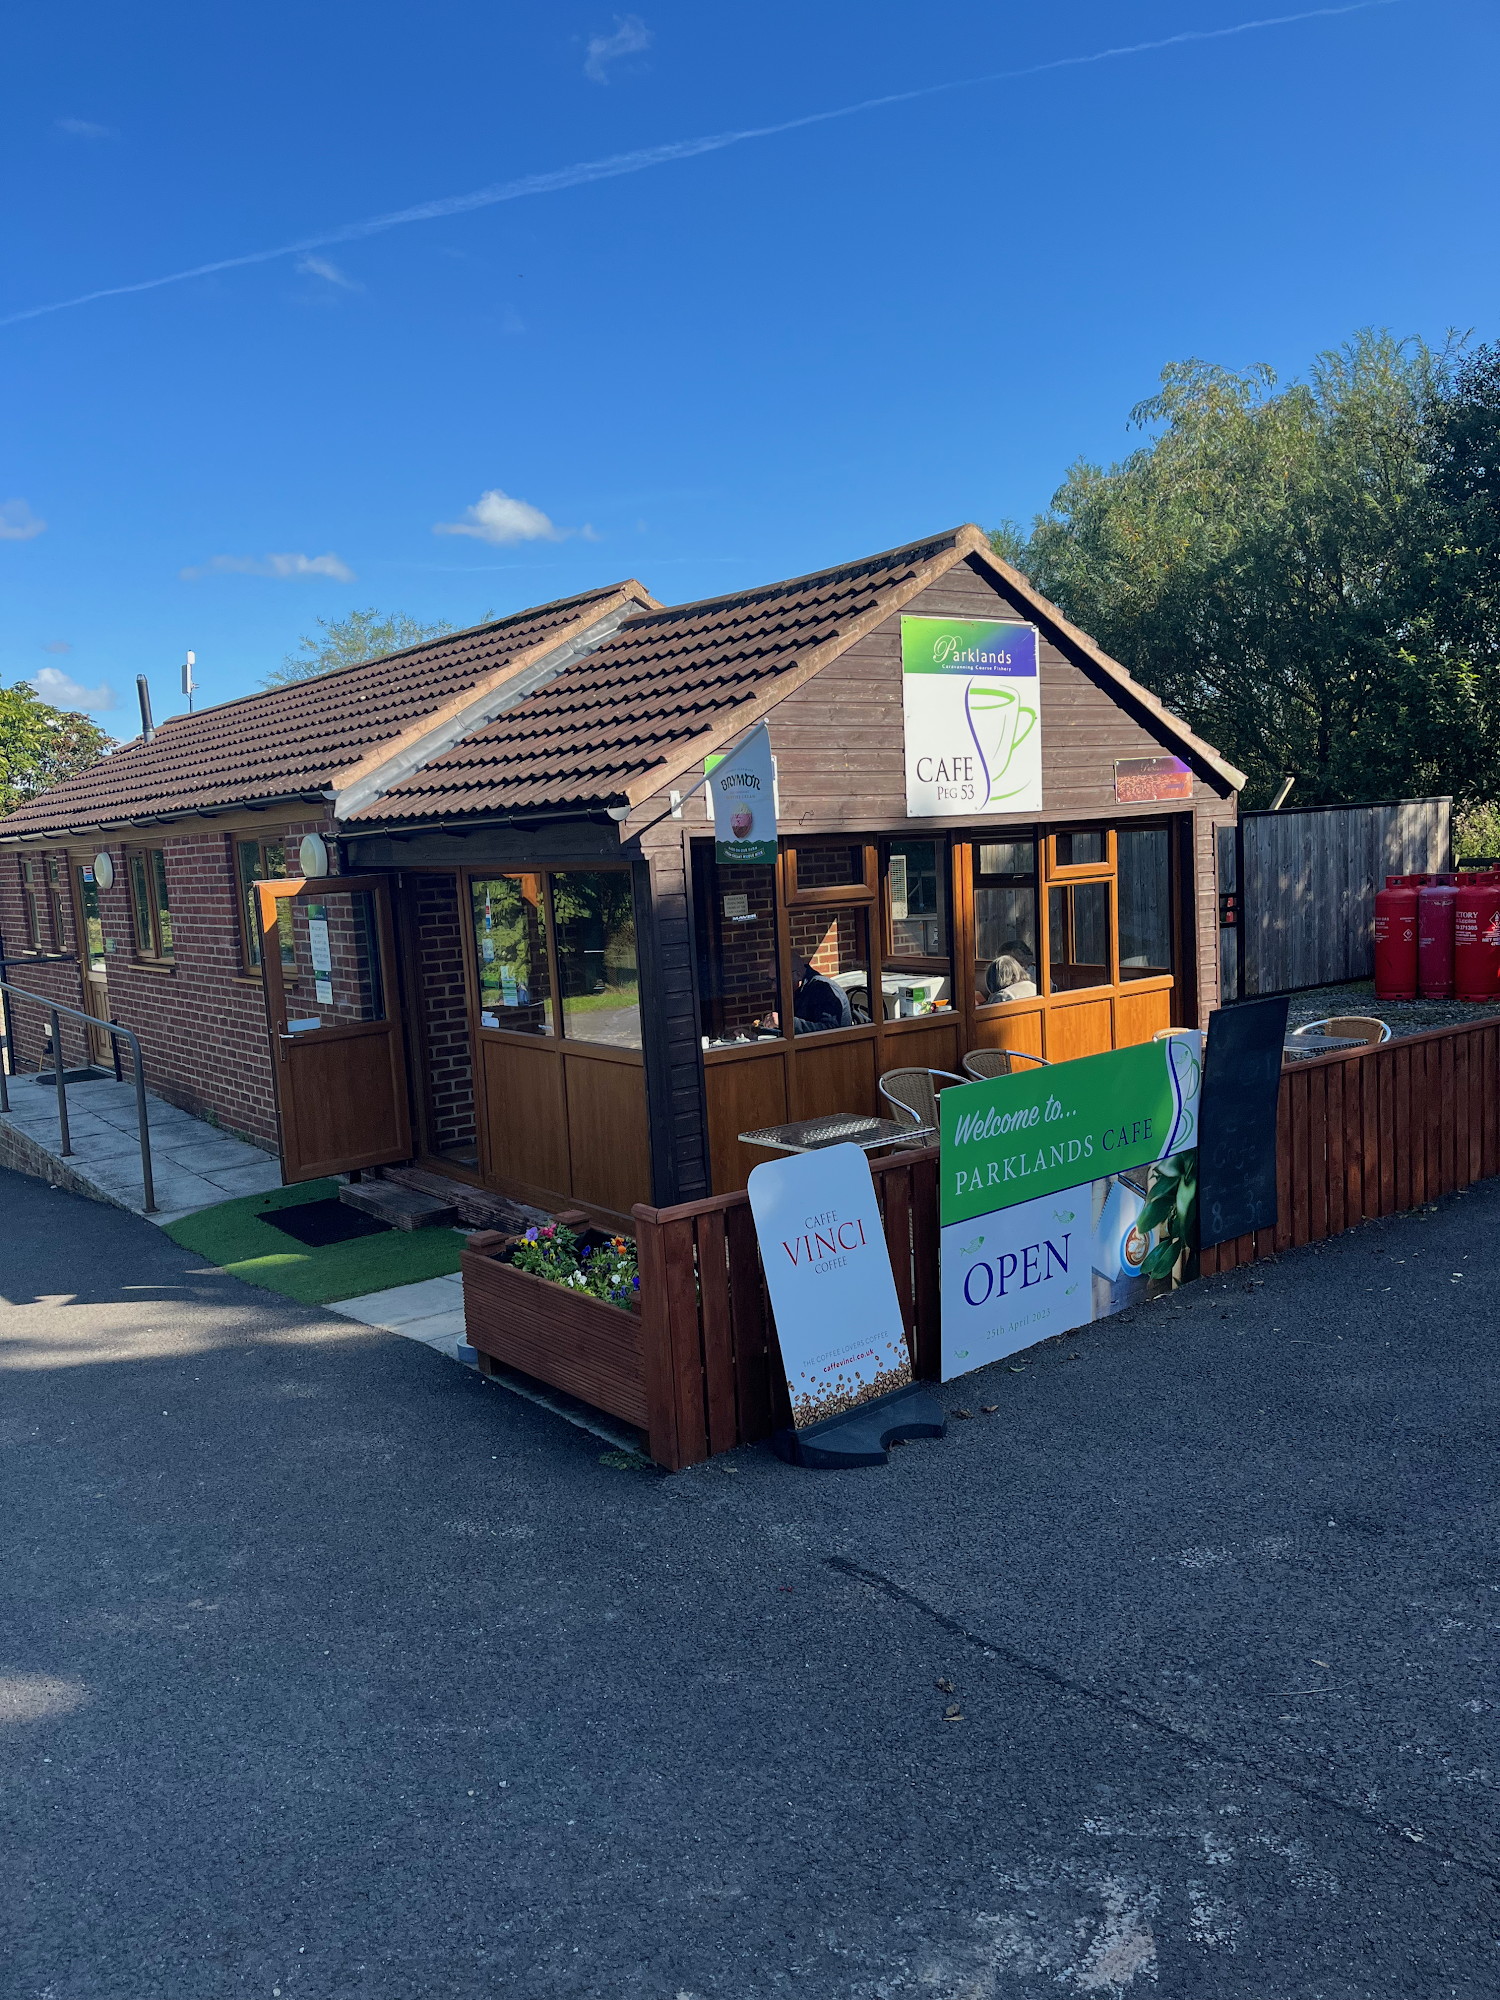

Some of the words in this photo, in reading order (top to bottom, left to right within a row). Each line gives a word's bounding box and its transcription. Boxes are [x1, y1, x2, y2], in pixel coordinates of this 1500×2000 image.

[933, 634, 1012, 664] Parklands
[942, 663, 974, 671] Caravanning
[916, 757, 974, 783] CAFE
[961, 784, 975, 800] 53
[954, 1105, 1040, 1147] Welcome
[1044, 1093, 1077, 1122] to...
[955, 1134, 1094, 1195] PARKLANDS
[1102, 1118, 1153, 1151] CAFE
[804, 1210, 838, 1230] CAFFE
[780, 1218, 868, 1267] VINCI
[814, 1256, 848, 1275] COFFEE
[963, 1232, 1072, 1307] OPEN
[986, 1325, 1005, 1340] 25th
[1008, 1315, 1029, 1332] April
[1032, 1308, 1051, 1322] 2023
[802, 1358, 815, 1368] THE
[816, 1350, 841, 1363] COFFEE
[841, 1340, 865, 1354] LOVERS
[865, 1330, 889, 1344] COFFEE
[823, 1348, 875, 1373] caffevinci.co.uk
